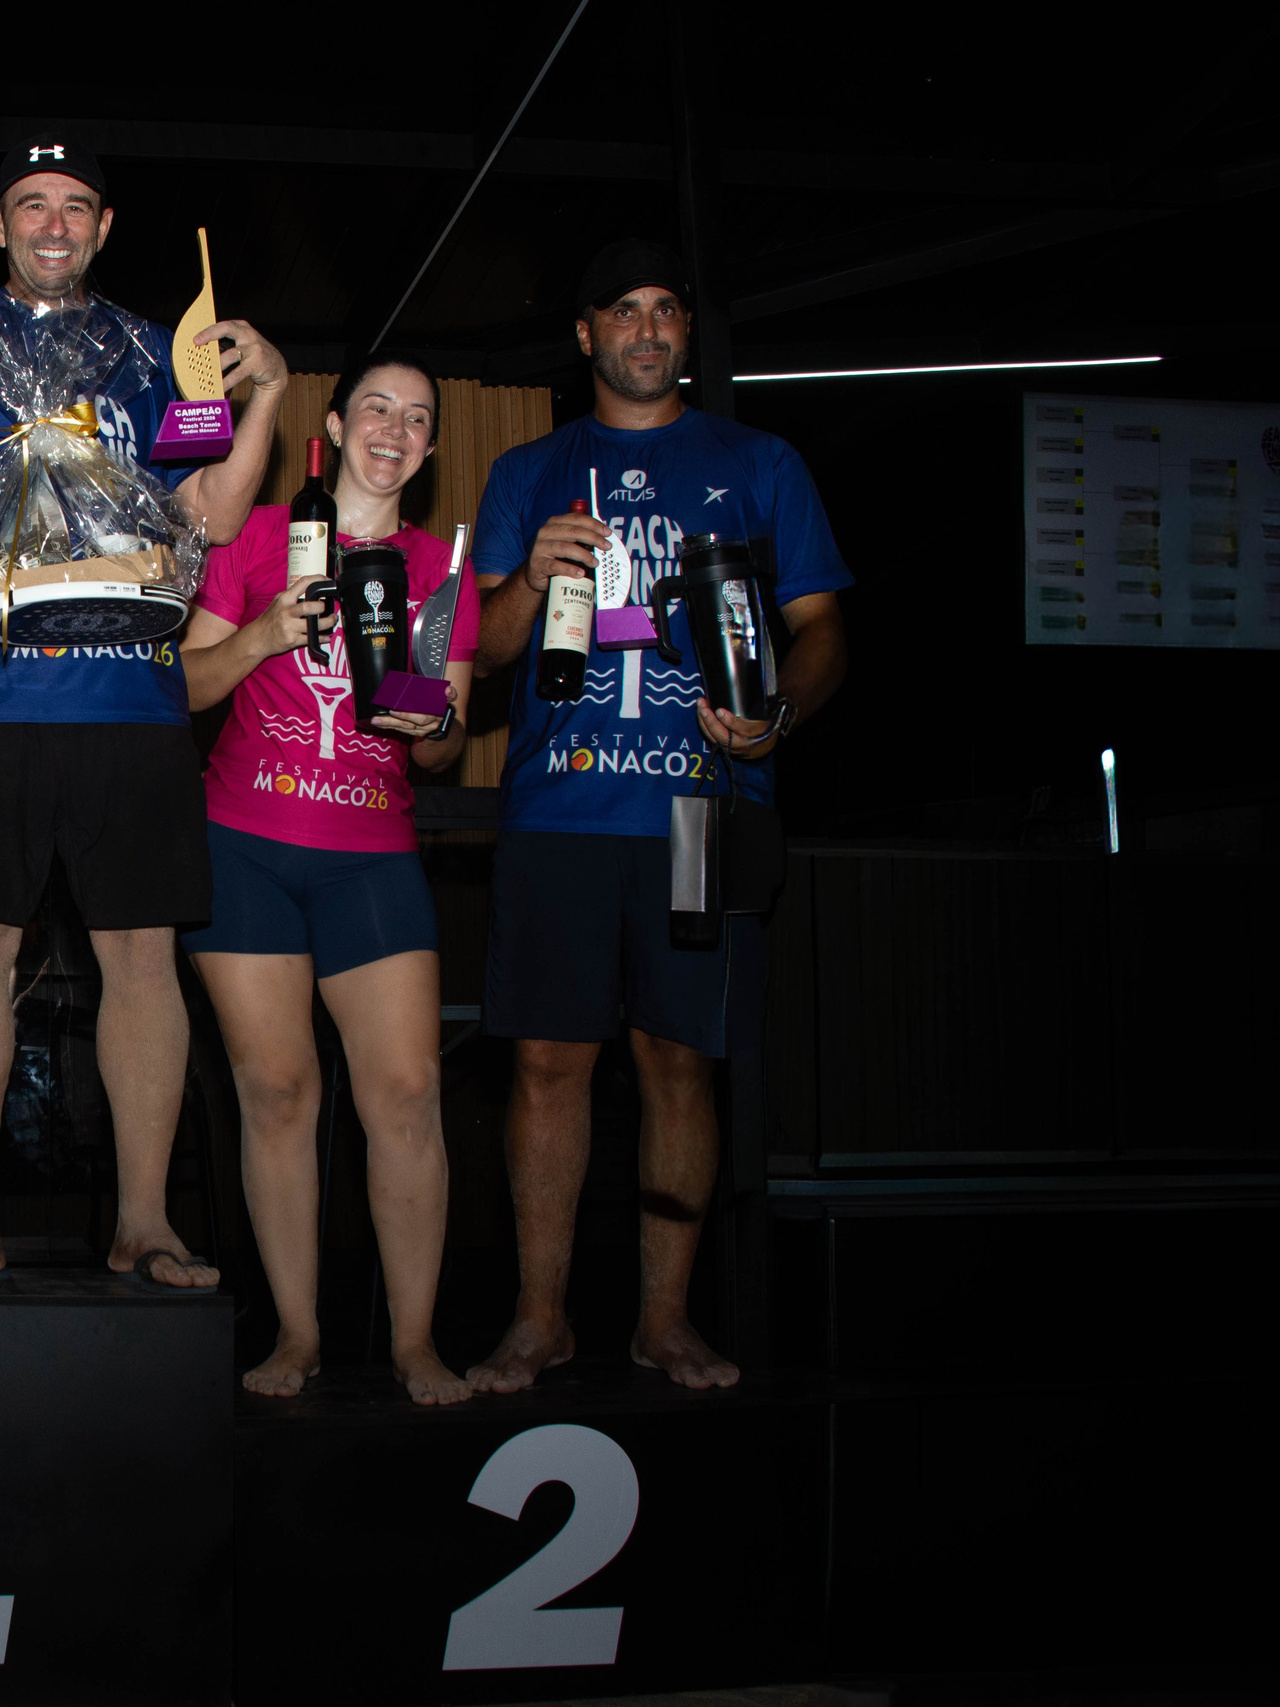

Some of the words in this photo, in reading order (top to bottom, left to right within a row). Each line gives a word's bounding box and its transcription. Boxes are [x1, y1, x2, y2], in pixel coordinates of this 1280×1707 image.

[174, 406, 222, 417] CAMPEÃO
[607, 487, 656, 502] ATLAS
[289, 535, 312, 544] ORO
[561, 586, 592, 602] TORO
[549, 733, 711, 753] FESTIVAL
[258, 758, 385, 789] FESTIVAL
[253, 770, 388, 810] MONACO26
[441, 1423, 641, 1672] 2
